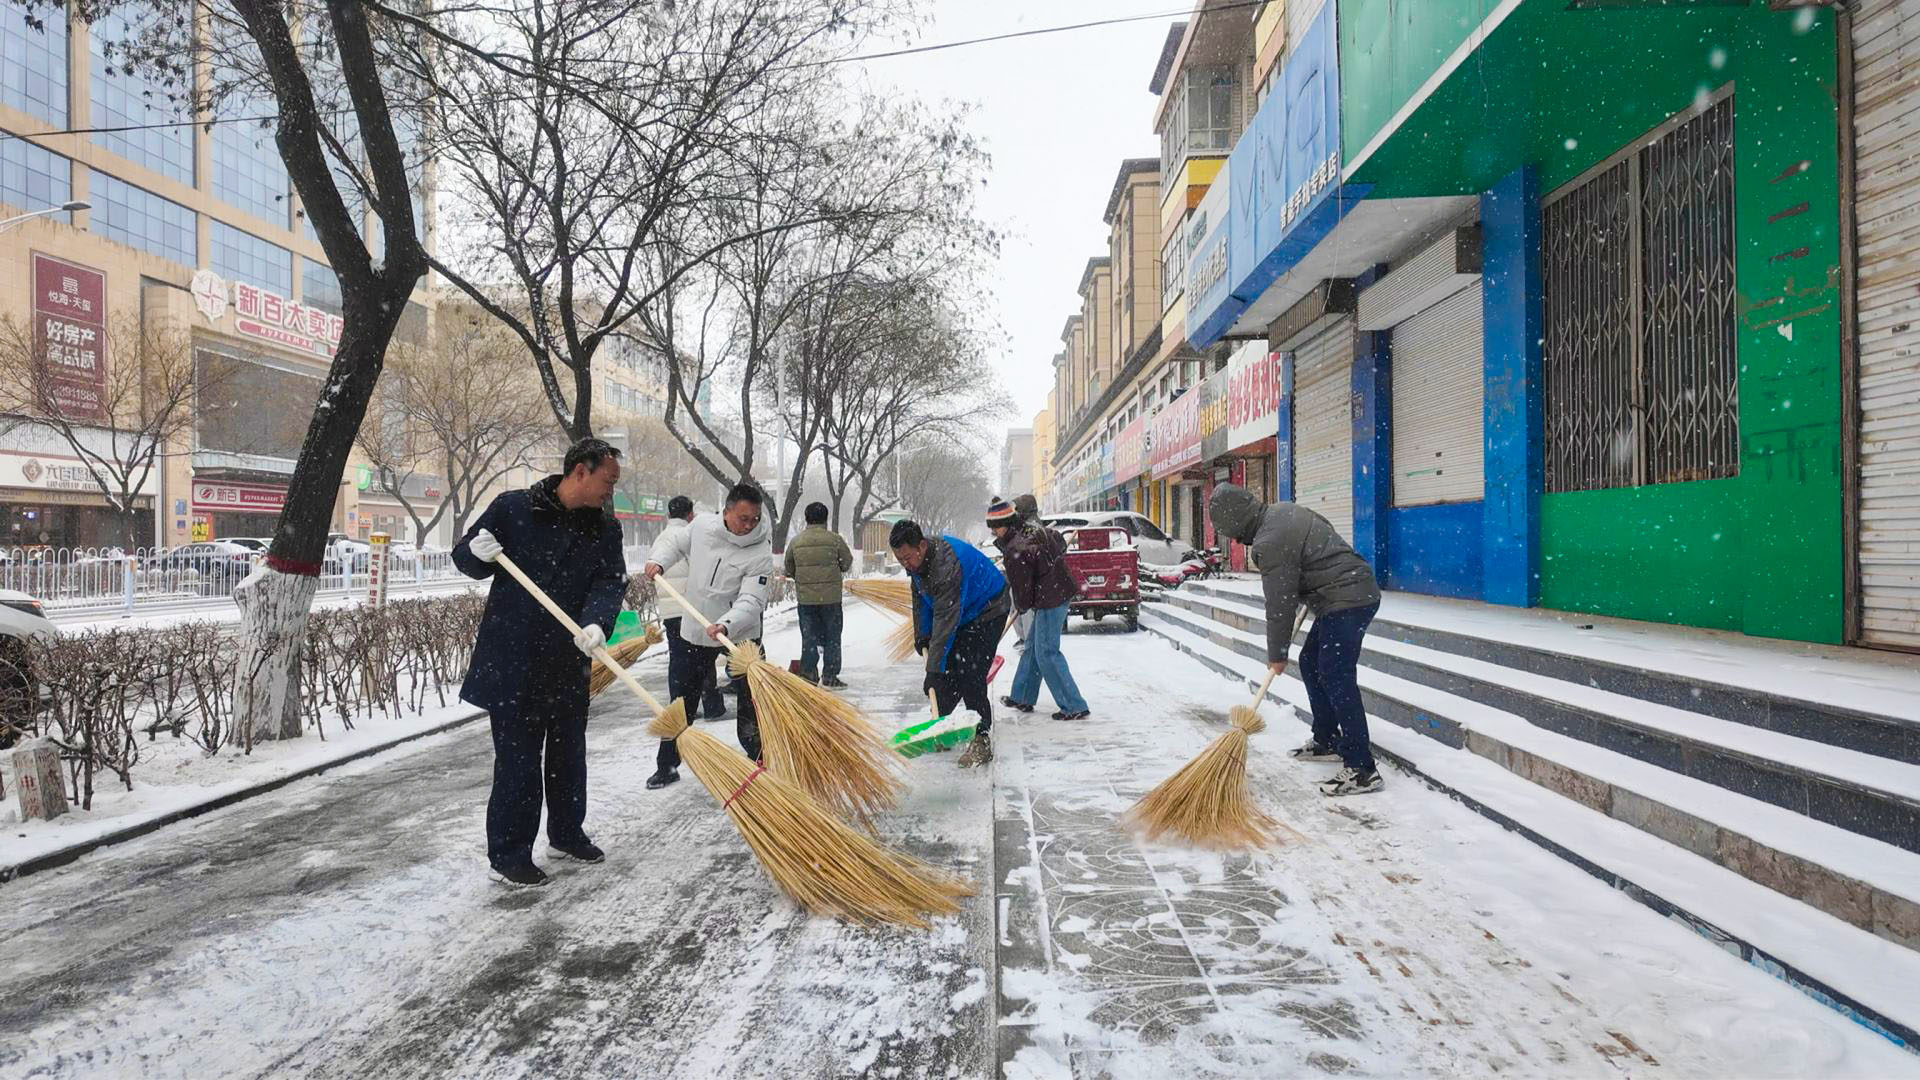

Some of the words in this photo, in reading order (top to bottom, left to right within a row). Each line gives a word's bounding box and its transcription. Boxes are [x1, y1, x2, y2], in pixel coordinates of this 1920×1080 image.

[46, 318, 96, 346] 好房产
[216, 488, 237, 502] 新百
